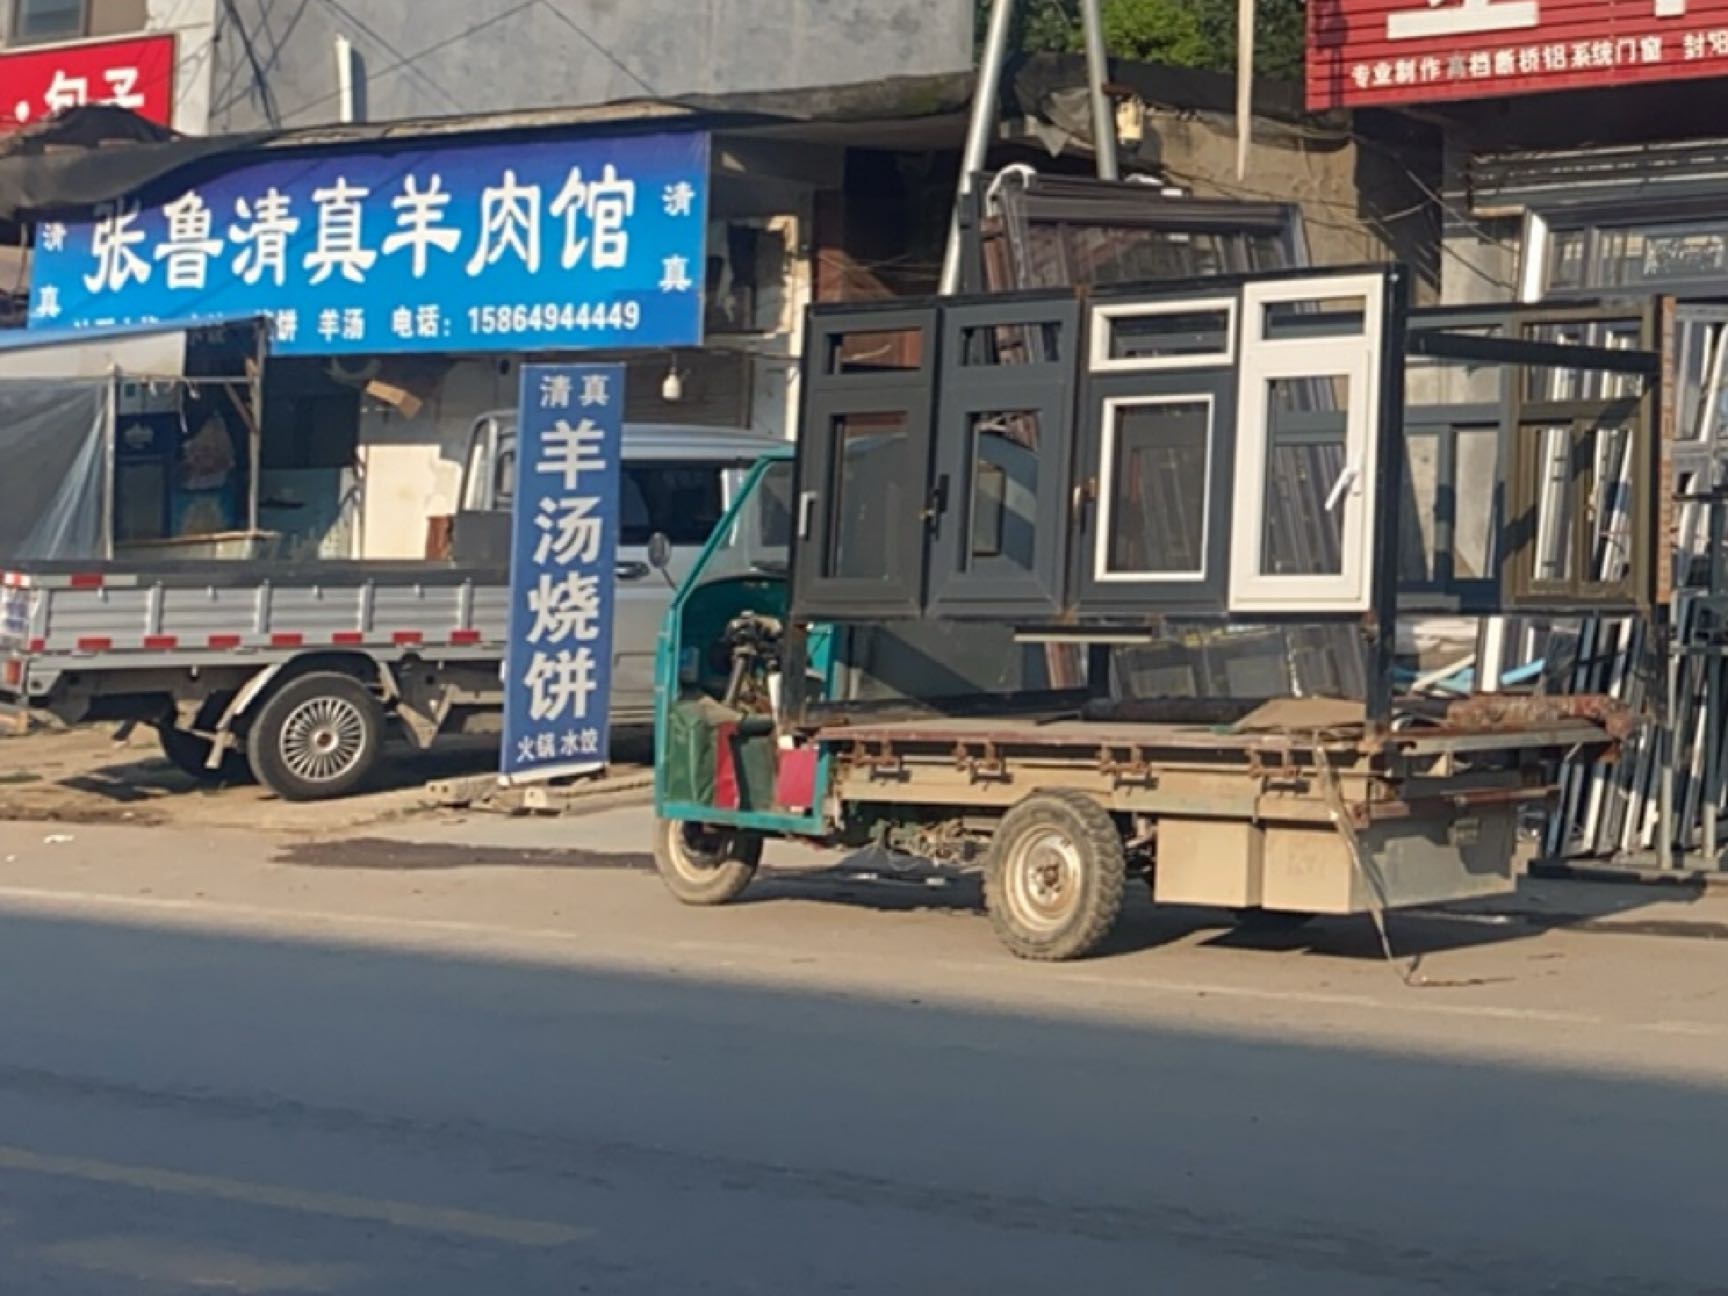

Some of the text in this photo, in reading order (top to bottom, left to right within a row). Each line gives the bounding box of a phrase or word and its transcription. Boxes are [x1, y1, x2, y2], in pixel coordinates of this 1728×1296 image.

[83, 163, 636, 294] 张鲁清真羊肉馆
[316, 307, 366, 342] 羊汤
[468, 301, 641, 334] 15864944449
[539, 374, 611, 409] 清真
[523, 417, 607, 722] 羊汤烧饼
